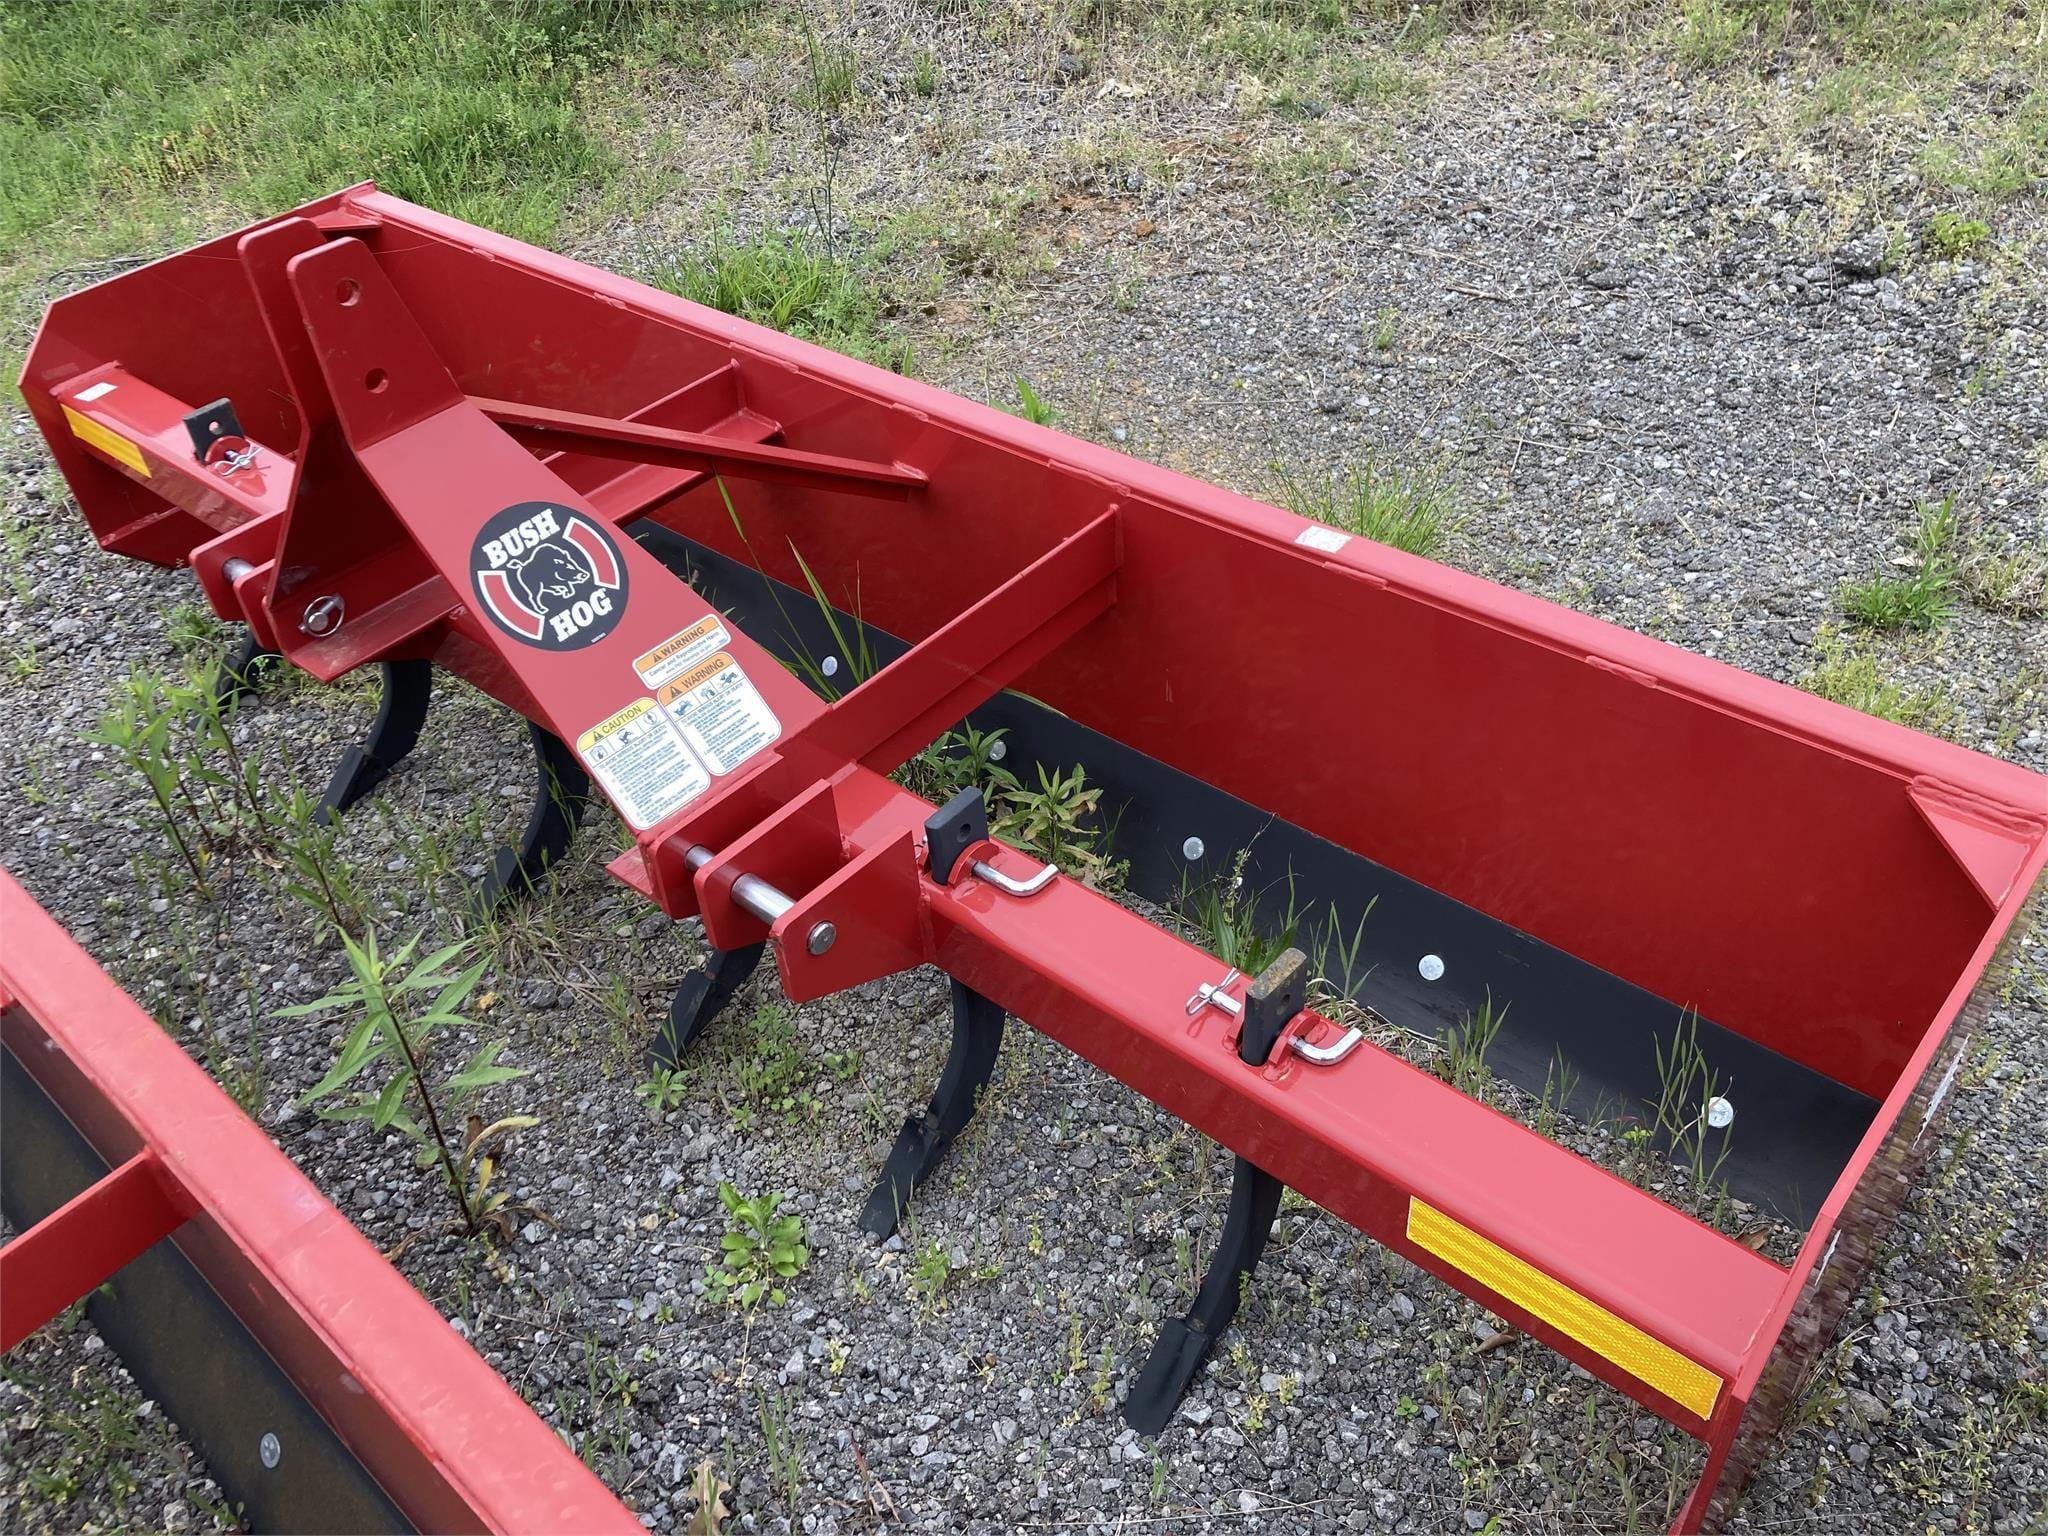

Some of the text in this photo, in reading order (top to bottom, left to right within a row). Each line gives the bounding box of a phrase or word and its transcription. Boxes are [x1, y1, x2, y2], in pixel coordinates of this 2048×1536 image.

[482, 508, 561, 569] BUSH
[549, 588, 613, 642] HOG
[661, 626, 705, 657] WARNING
[681, 658, 725, 689] WARNING
[601, 704, 642, 735] CAUTION
